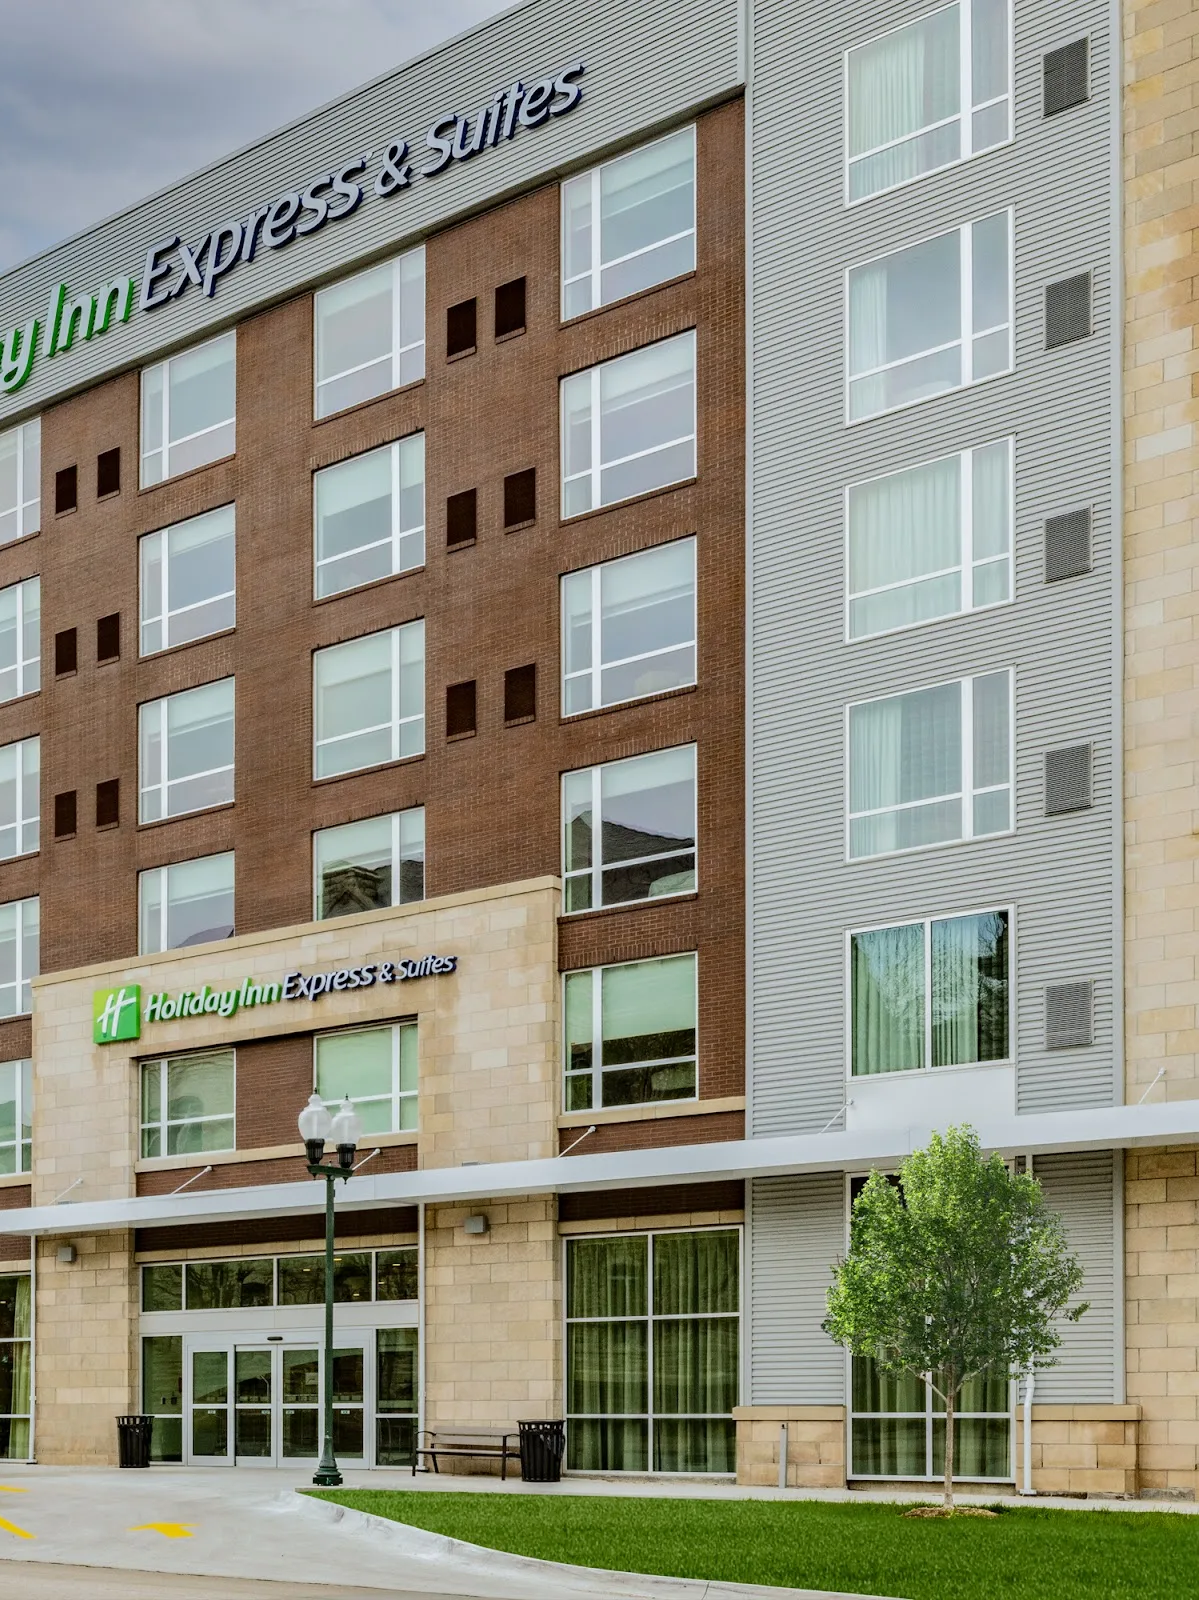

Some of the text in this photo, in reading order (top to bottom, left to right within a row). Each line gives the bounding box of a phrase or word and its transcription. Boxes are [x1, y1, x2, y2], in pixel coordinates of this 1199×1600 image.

[42, 275, 134, 358] Inn
[139, 157, 368, 312] Express
[373, 138, 413, 199] &
[420, 62, 585, 178] Suites
[143, 984, 240, 1023] Holiday
[239, 976, 283, 1008] Inn
[281, 964, 378, 1002] Express
[378, 961, 394, 983] &
[395, 954, 458, 982] Suites
